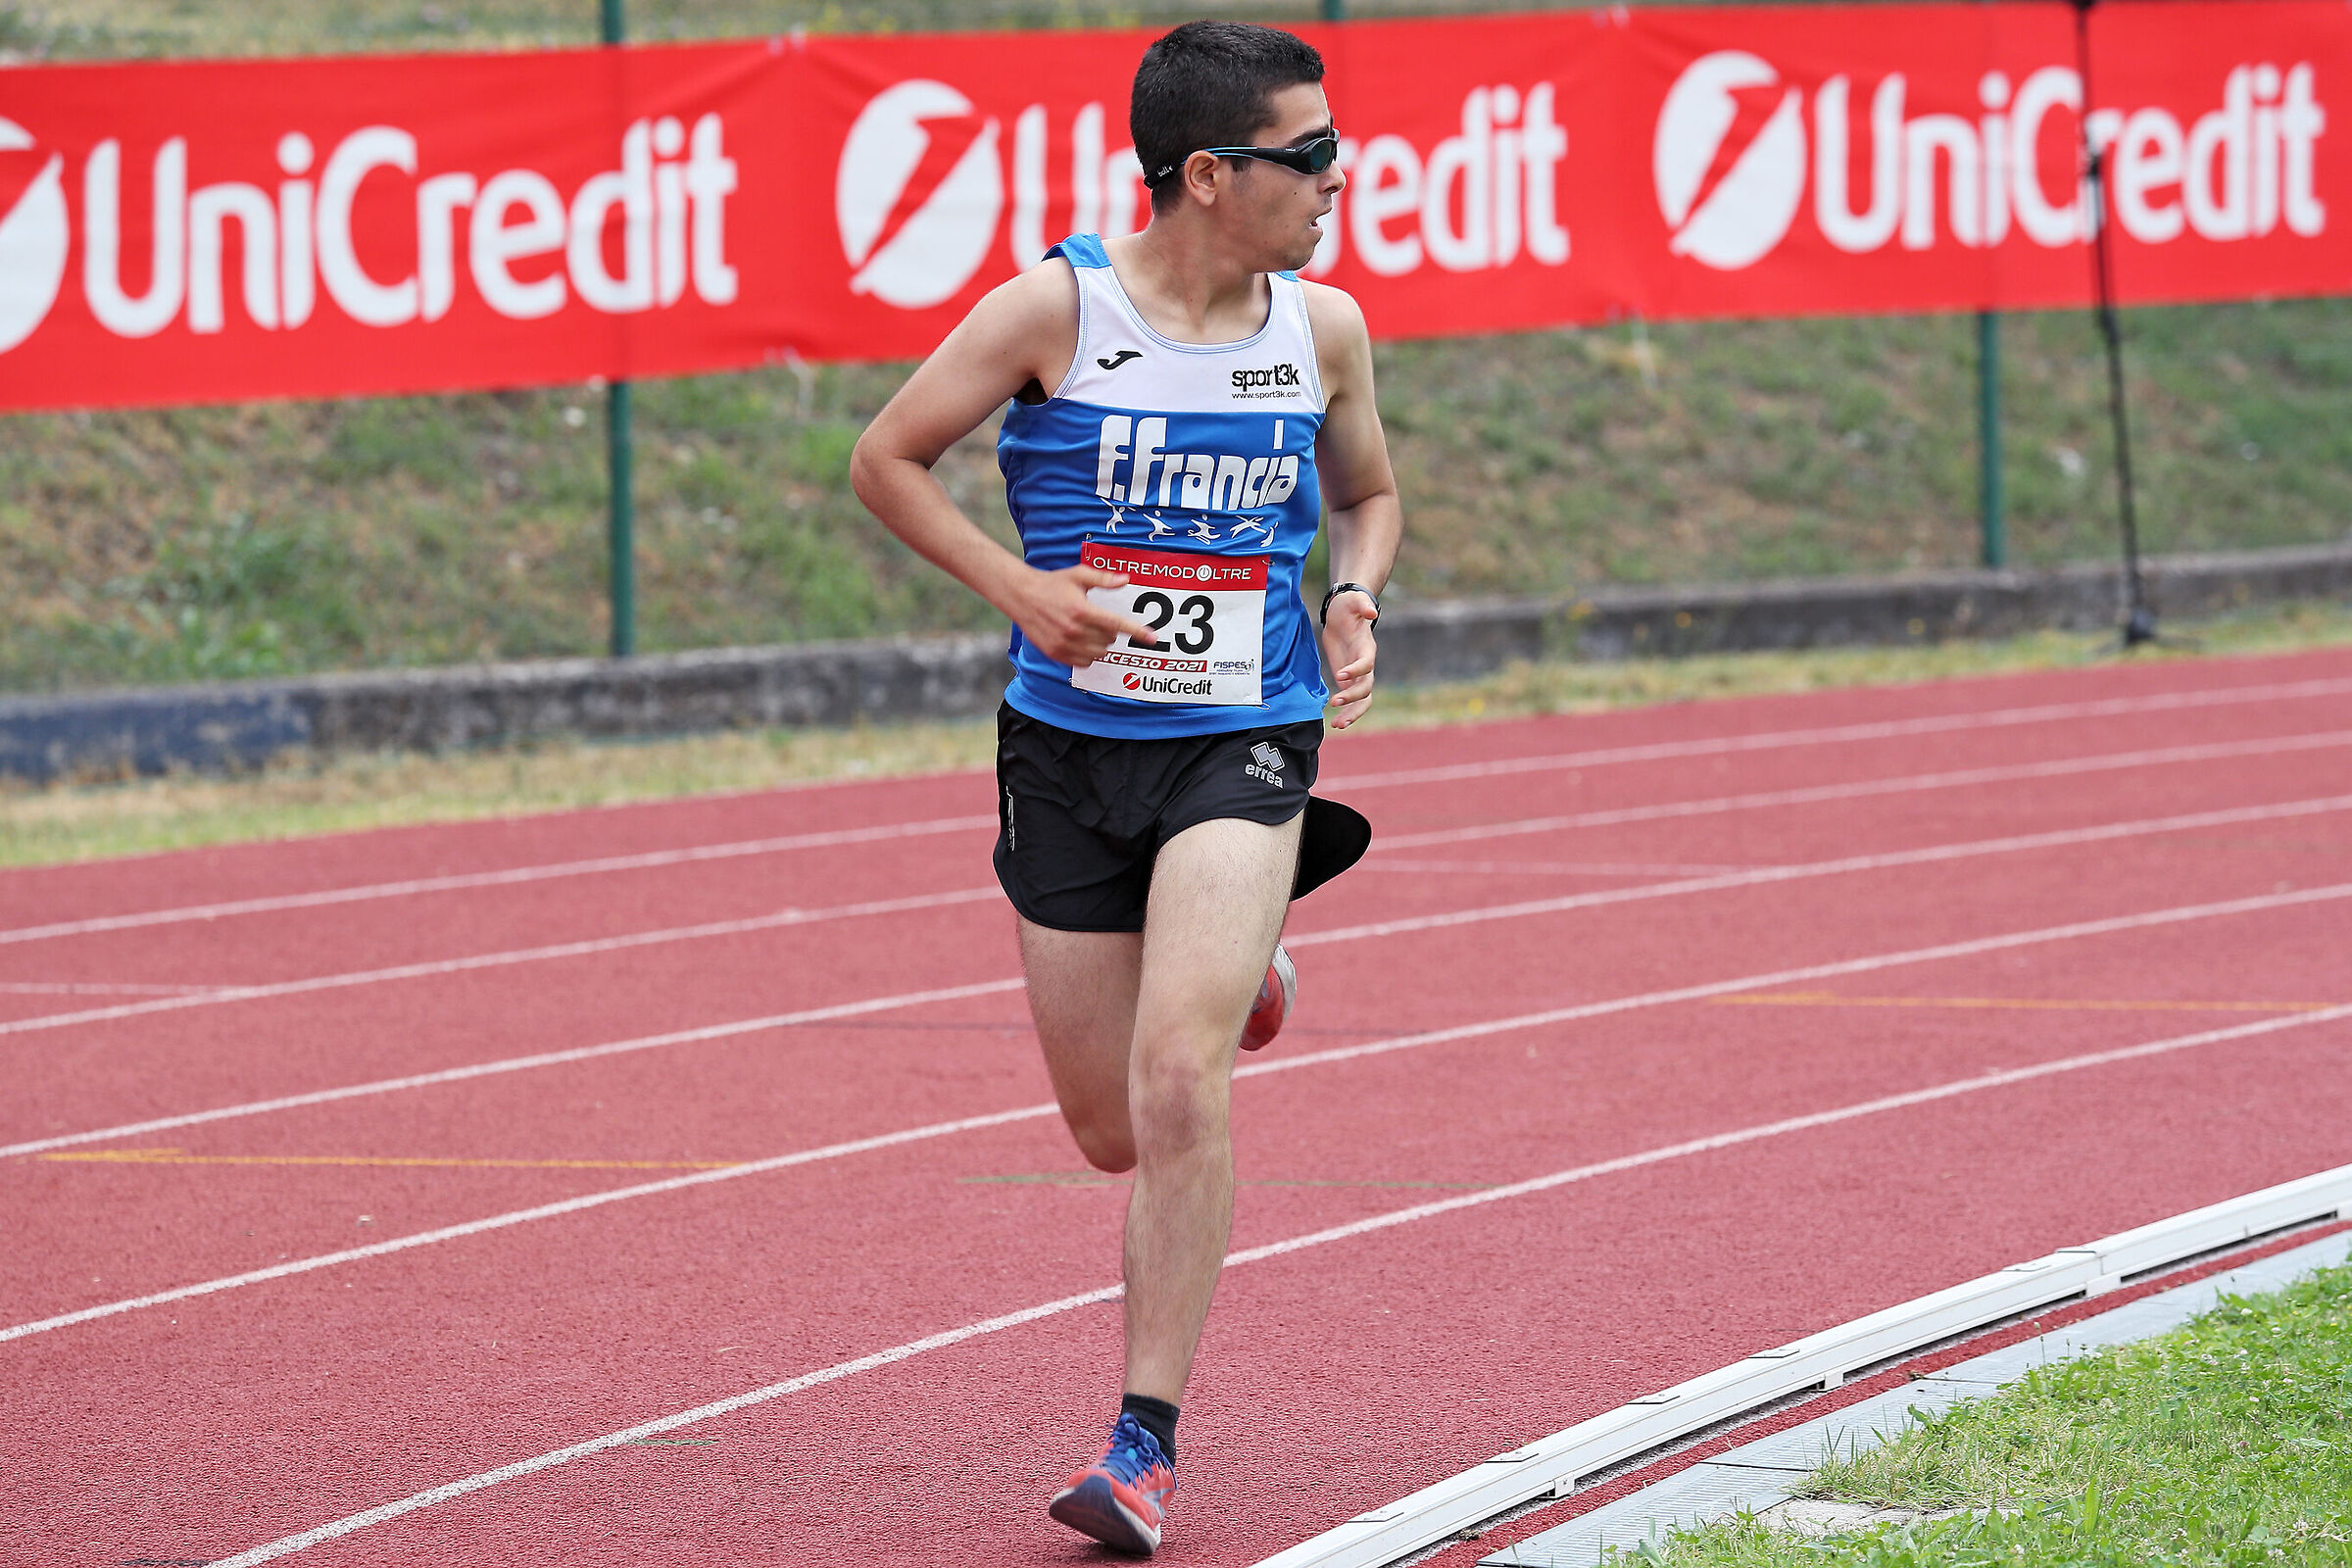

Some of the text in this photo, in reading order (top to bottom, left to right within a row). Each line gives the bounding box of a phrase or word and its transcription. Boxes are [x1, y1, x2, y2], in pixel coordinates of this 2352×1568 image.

[1814, 62, 2326, 254] UniCredit
[84, 113, 738, 338] UniCredit
[1232, 364, 1300, 392] sport3k
[1232, 391, 1301, 400] www.sport3k.com
[1127, 591, 1215, 655] 23
[1163, 661, 1204, 671] 2021
[1142, 676, 1212, 695] UniCredit
